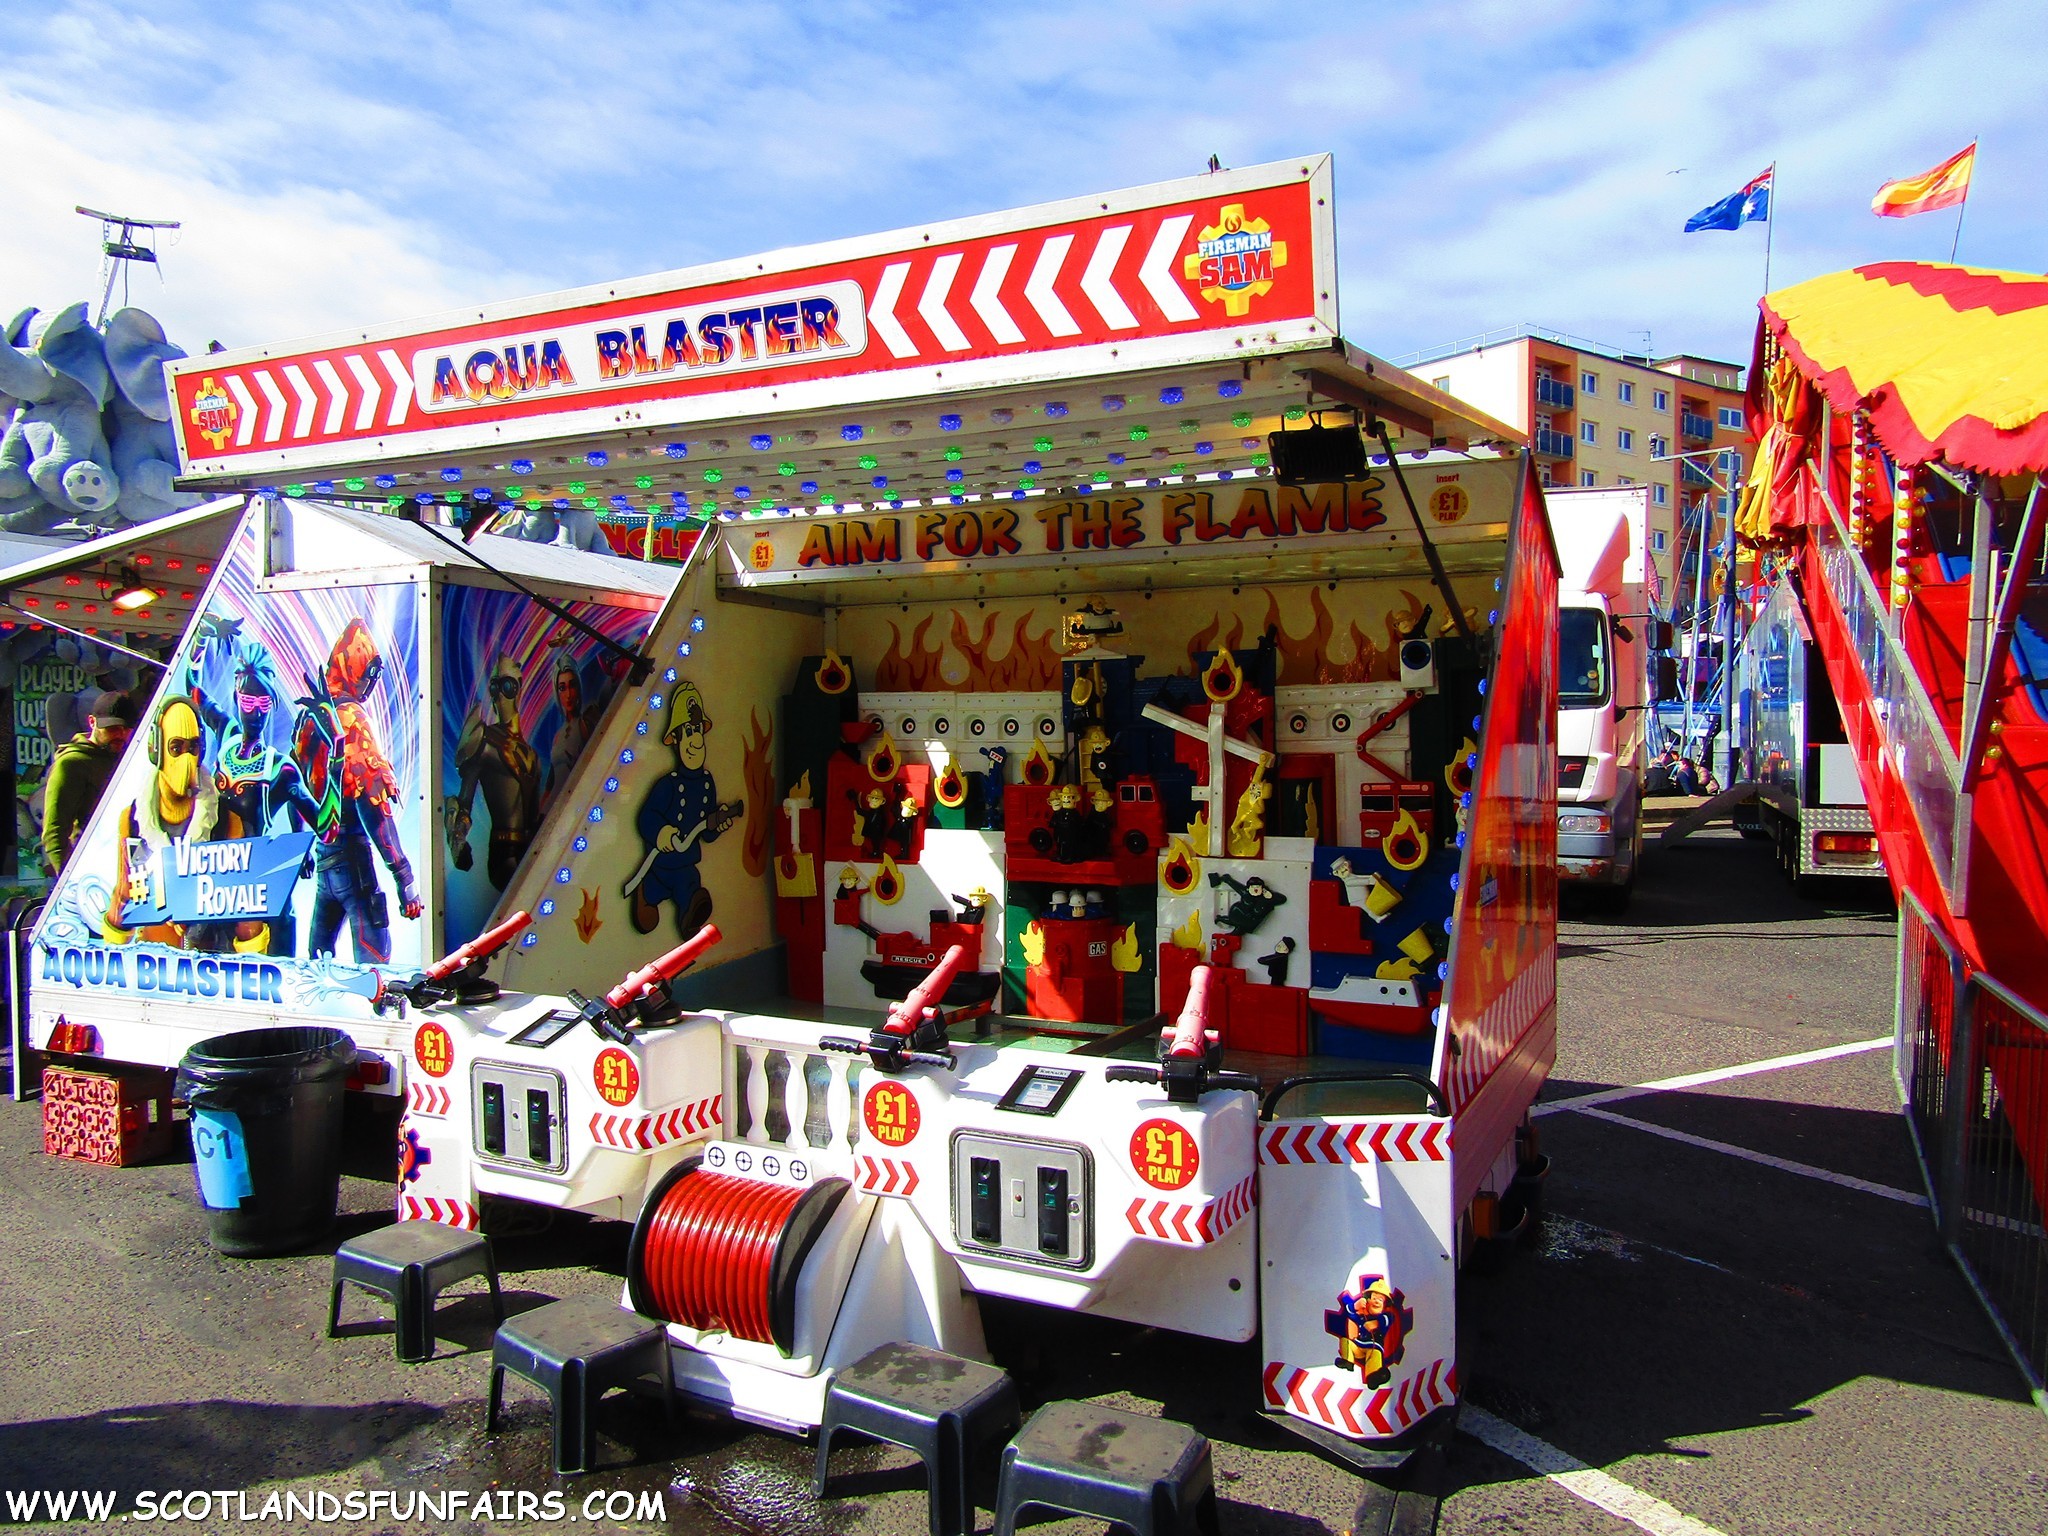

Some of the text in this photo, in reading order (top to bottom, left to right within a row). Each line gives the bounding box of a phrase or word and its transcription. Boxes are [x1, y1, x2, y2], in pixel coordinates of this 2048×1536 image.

[1198, 232, 1272, 258] FIREMAN
[1199, 248, 1274, 289] SAM
[430, 297, 850, 403] AQUA BLASTER
[198, 409, 233, 431] SAM
[1438, 492, 1460, 511] £1
[798, 476, 1388, 568] AIM FOR THE FLAME
[1439, 511, 1458, 521] PLAY
[755, 545, 769, 559] £1
[755, 560, 768, 569] PLAY
[1089, 942, 1106, 956] GAS
[43, 947, 283, 1003] AQUA BLASTER
[423, 1029, 446, 1058] £1
[425, 1059, 445, 1073] PLAY
[602, 1054, 629, 1087] £1
[604, 1087, 627, 1103] PLAY
[875, 1090, 907, 1126] £1
[197, 1126, 233, 1159] C1
[877, 1126, 905, 1143] PLAY
[1145, 1127, 1183, 1167] £1
[1148, 1165, 1182, 1185] PLAY
